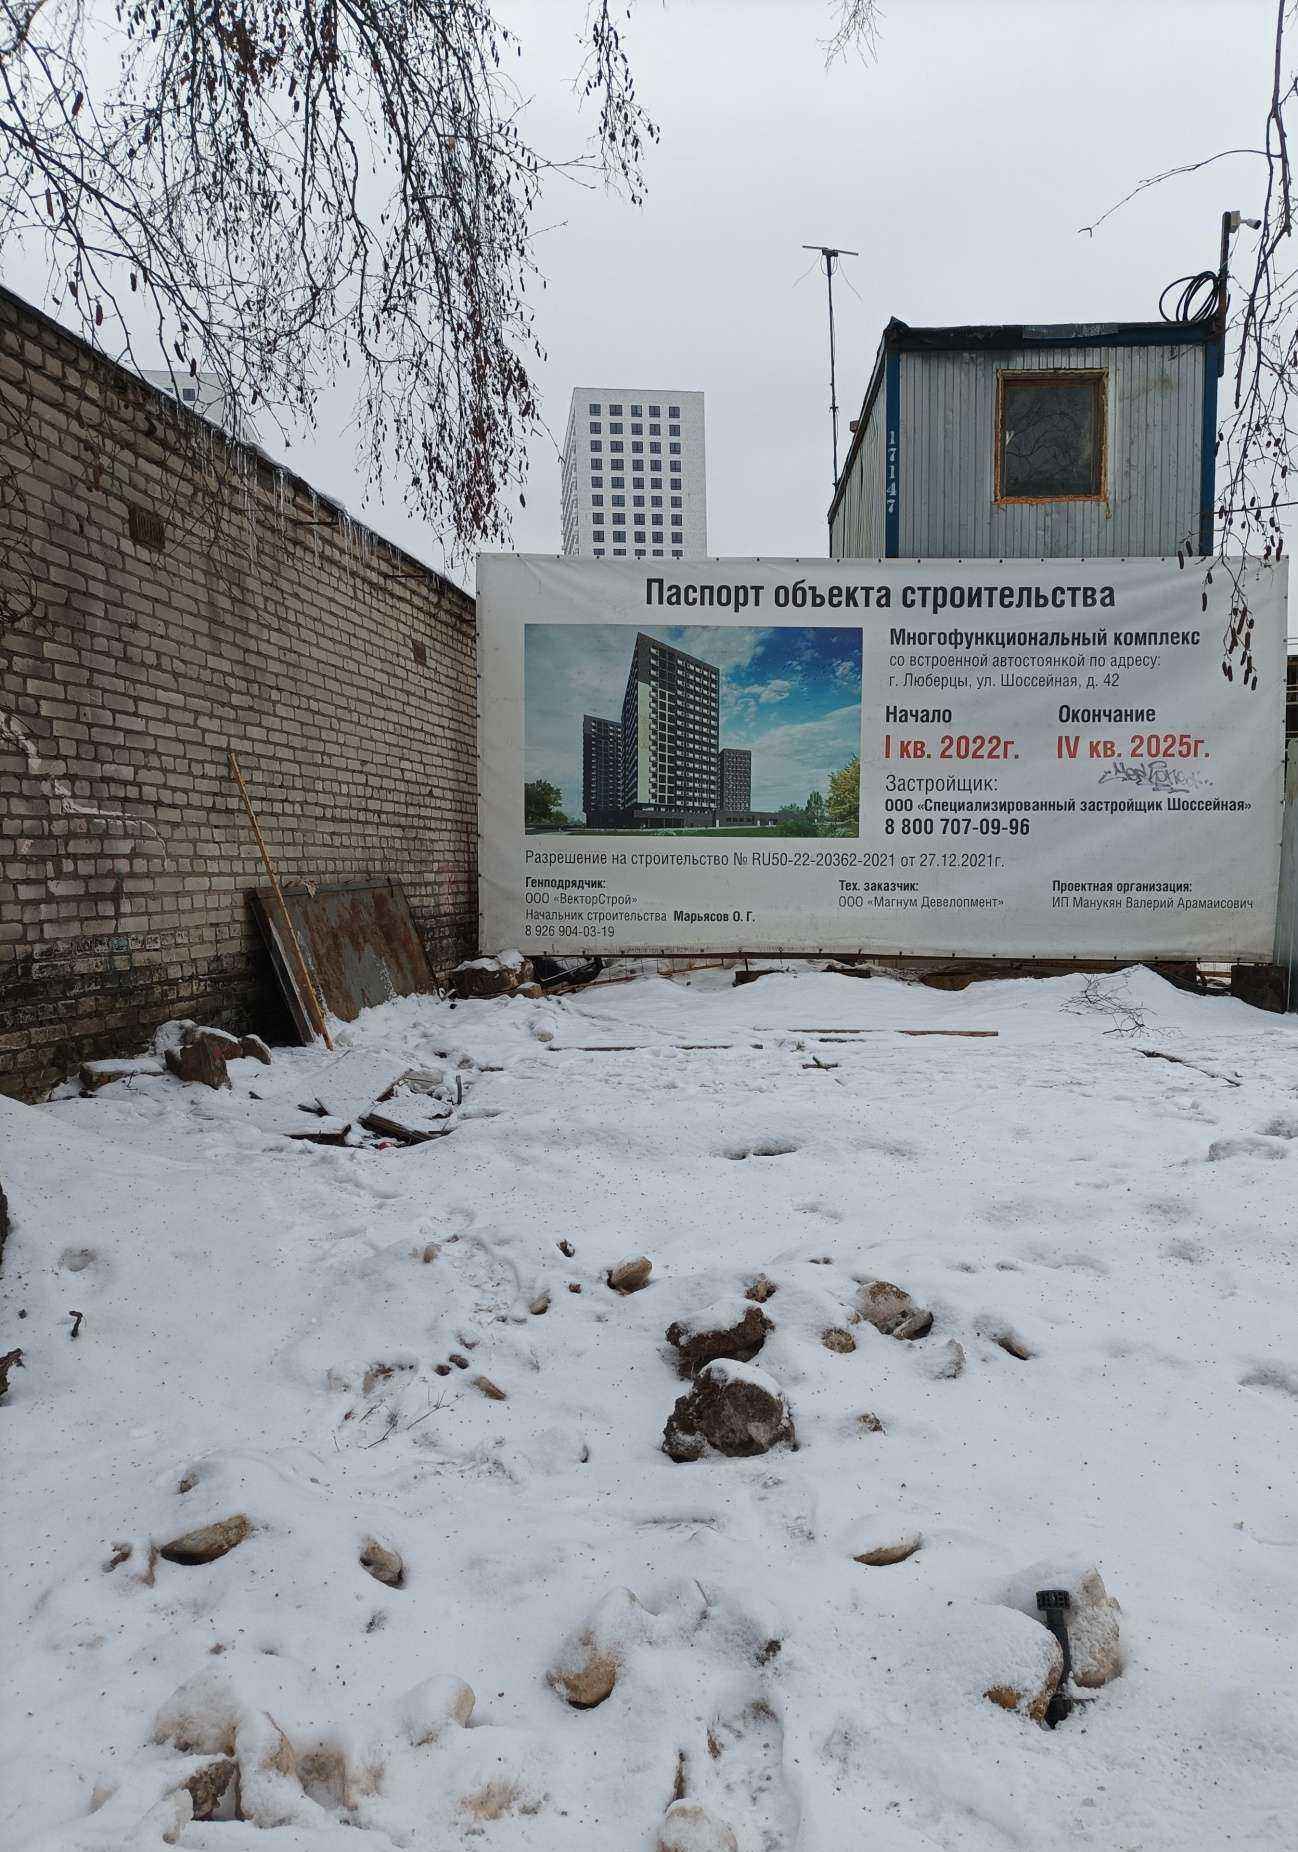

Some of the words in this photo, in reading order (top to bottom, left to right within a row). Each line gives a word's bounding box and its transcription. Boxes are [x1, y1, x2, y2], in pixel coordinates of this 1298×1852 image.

[886, 430, 897, 514] 17147
[646, 578, 764, 612] Паспорт
[774, 579, 891, 608] объекта
[902, 584, 1116, 613] строительства
[889, 627, 1107, 649] Многофункциональный
[1113, 630, 1200, 646] комплекс
[889, 656, 906, 667] со
[910, 653, 989, 667] встроенной
[992, 653, 1086, 667] автостоянкой
[1089, 656, 1106, 667] по
[1110, 655, 1161, 670] адресу:
[889, 677, 897, 687] г.
[903, 673, 972, 689] Люберцы,
[976, 676, 996, 689] ул.
[1000, 672, 1082, 689] Шоссейная,
[1086, 676, 1099, 689] д.
[1103, 673, 1120, 687] 42
[885, 705, 953, 723] Начало
[1058, 704, 1156, 722] Окончание
[884, 735, 891, 758] I
[899, 740, 932, 759] кв.
[940, 735, 1020, 760] 2022г.
[1057, 736, 1080, 759] IV
[1089, 740, 1122, 758] кв.
[1130, 734, 1210, 758] 2025г.
[885, 774, 998, 793] Застройщик:
[885, 799, 913, 812] ООО
[917, 797, 1076, 814] «Специализированный
[1080, 797, 1163, 815] застройщик
[1167, 797, 1252, 812] Шоссейная»
[885, 819, 895, 835] 8
[901, 819, 934, 836] 800
[940, 818, 1030, 836] 707-09-96
[525, 849, 607, 866] Разрешение
[612, 854, 627, 865] на
[631, 853, 729, 867] строительство
[733, 851, 748, 866] №
[751, 851, 895, 867] RU50-22-20362-2021
[900, 855, 916, 867] от
[920, 853, 1005, 868] 27.12.2021г.
[525, 876, 606, 890] Генподрядчик:
[838, 880, 860, 891] Тех.
[864, 881, 919, 892] заказчик:
[1052, 880, 1113, 893] Проектная
[1116, 880, 1193, 893] организация:
[525, 892, 550, 904] ООО
[553, 892, 638, 905] «ВекторСтрой»
[838, 896, 864, 908] ООО
[867, 895, 918, 909] «Магнум
[921, 896, 1004, 909] Девелопмент»
[1052, 897, 1069, 908] ИП
[1072, 897, 1122, 911] Манукян
[1126, 896, 1174, 910] Валерий
[525, 910, 583, 922] Начальник
[587, 912, 668, 923] строительства
[673, 911, 729, 923] Марьясов
[732, 911, 743, 922] О.
[745, 911, 756, 922] Г.
[525, 925, 532, 937] 8
[535, 925, 555, 937] 926
[559, 925, 615, 937] 904-03-19
